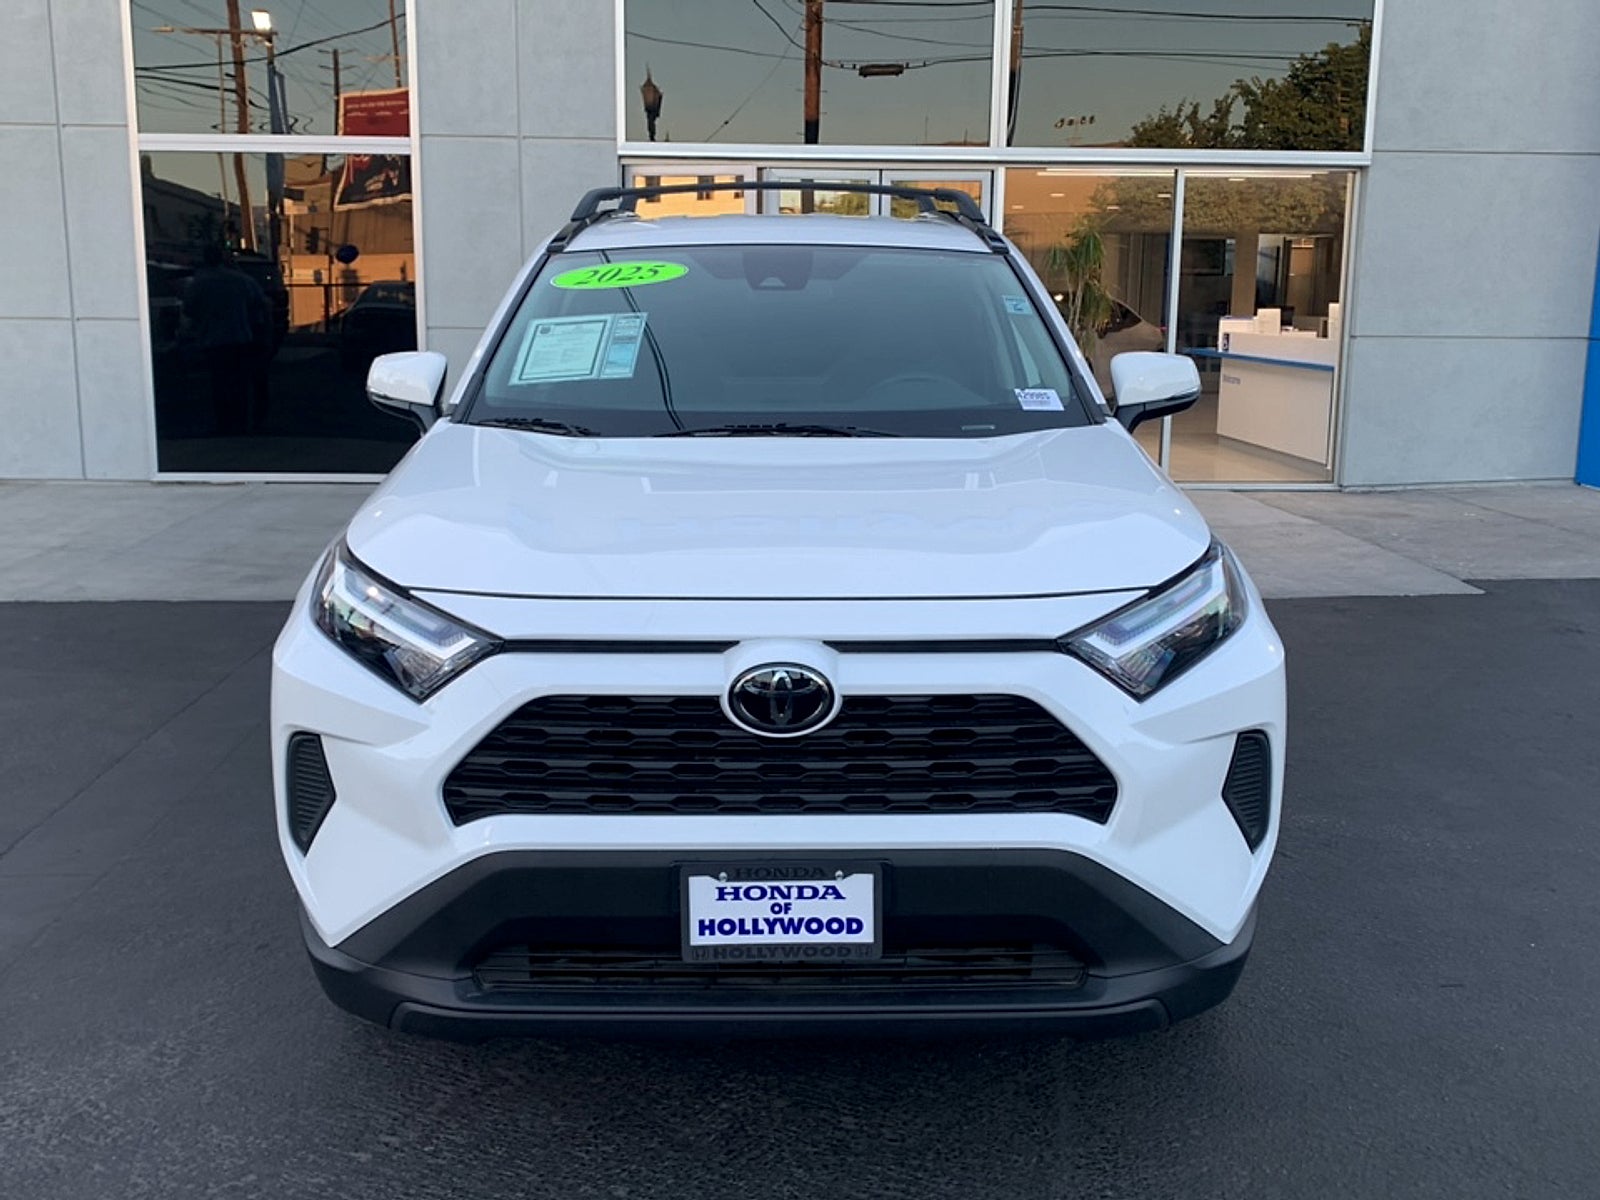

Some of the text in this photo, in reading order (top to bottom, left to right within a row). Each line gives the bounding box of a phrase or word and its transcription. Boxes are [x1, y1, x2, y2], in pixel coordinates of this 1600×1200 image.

[574, 265, 666, 285] 2025
[734, 867, 827, 880] HONDA
[716, 885, 846, 901] HONDA
[770, 902, 792, 915] OF
[698, 917, 864, 936] HOLLYWOOD
[713, 945, 850, 960] HOLLYWOOD
